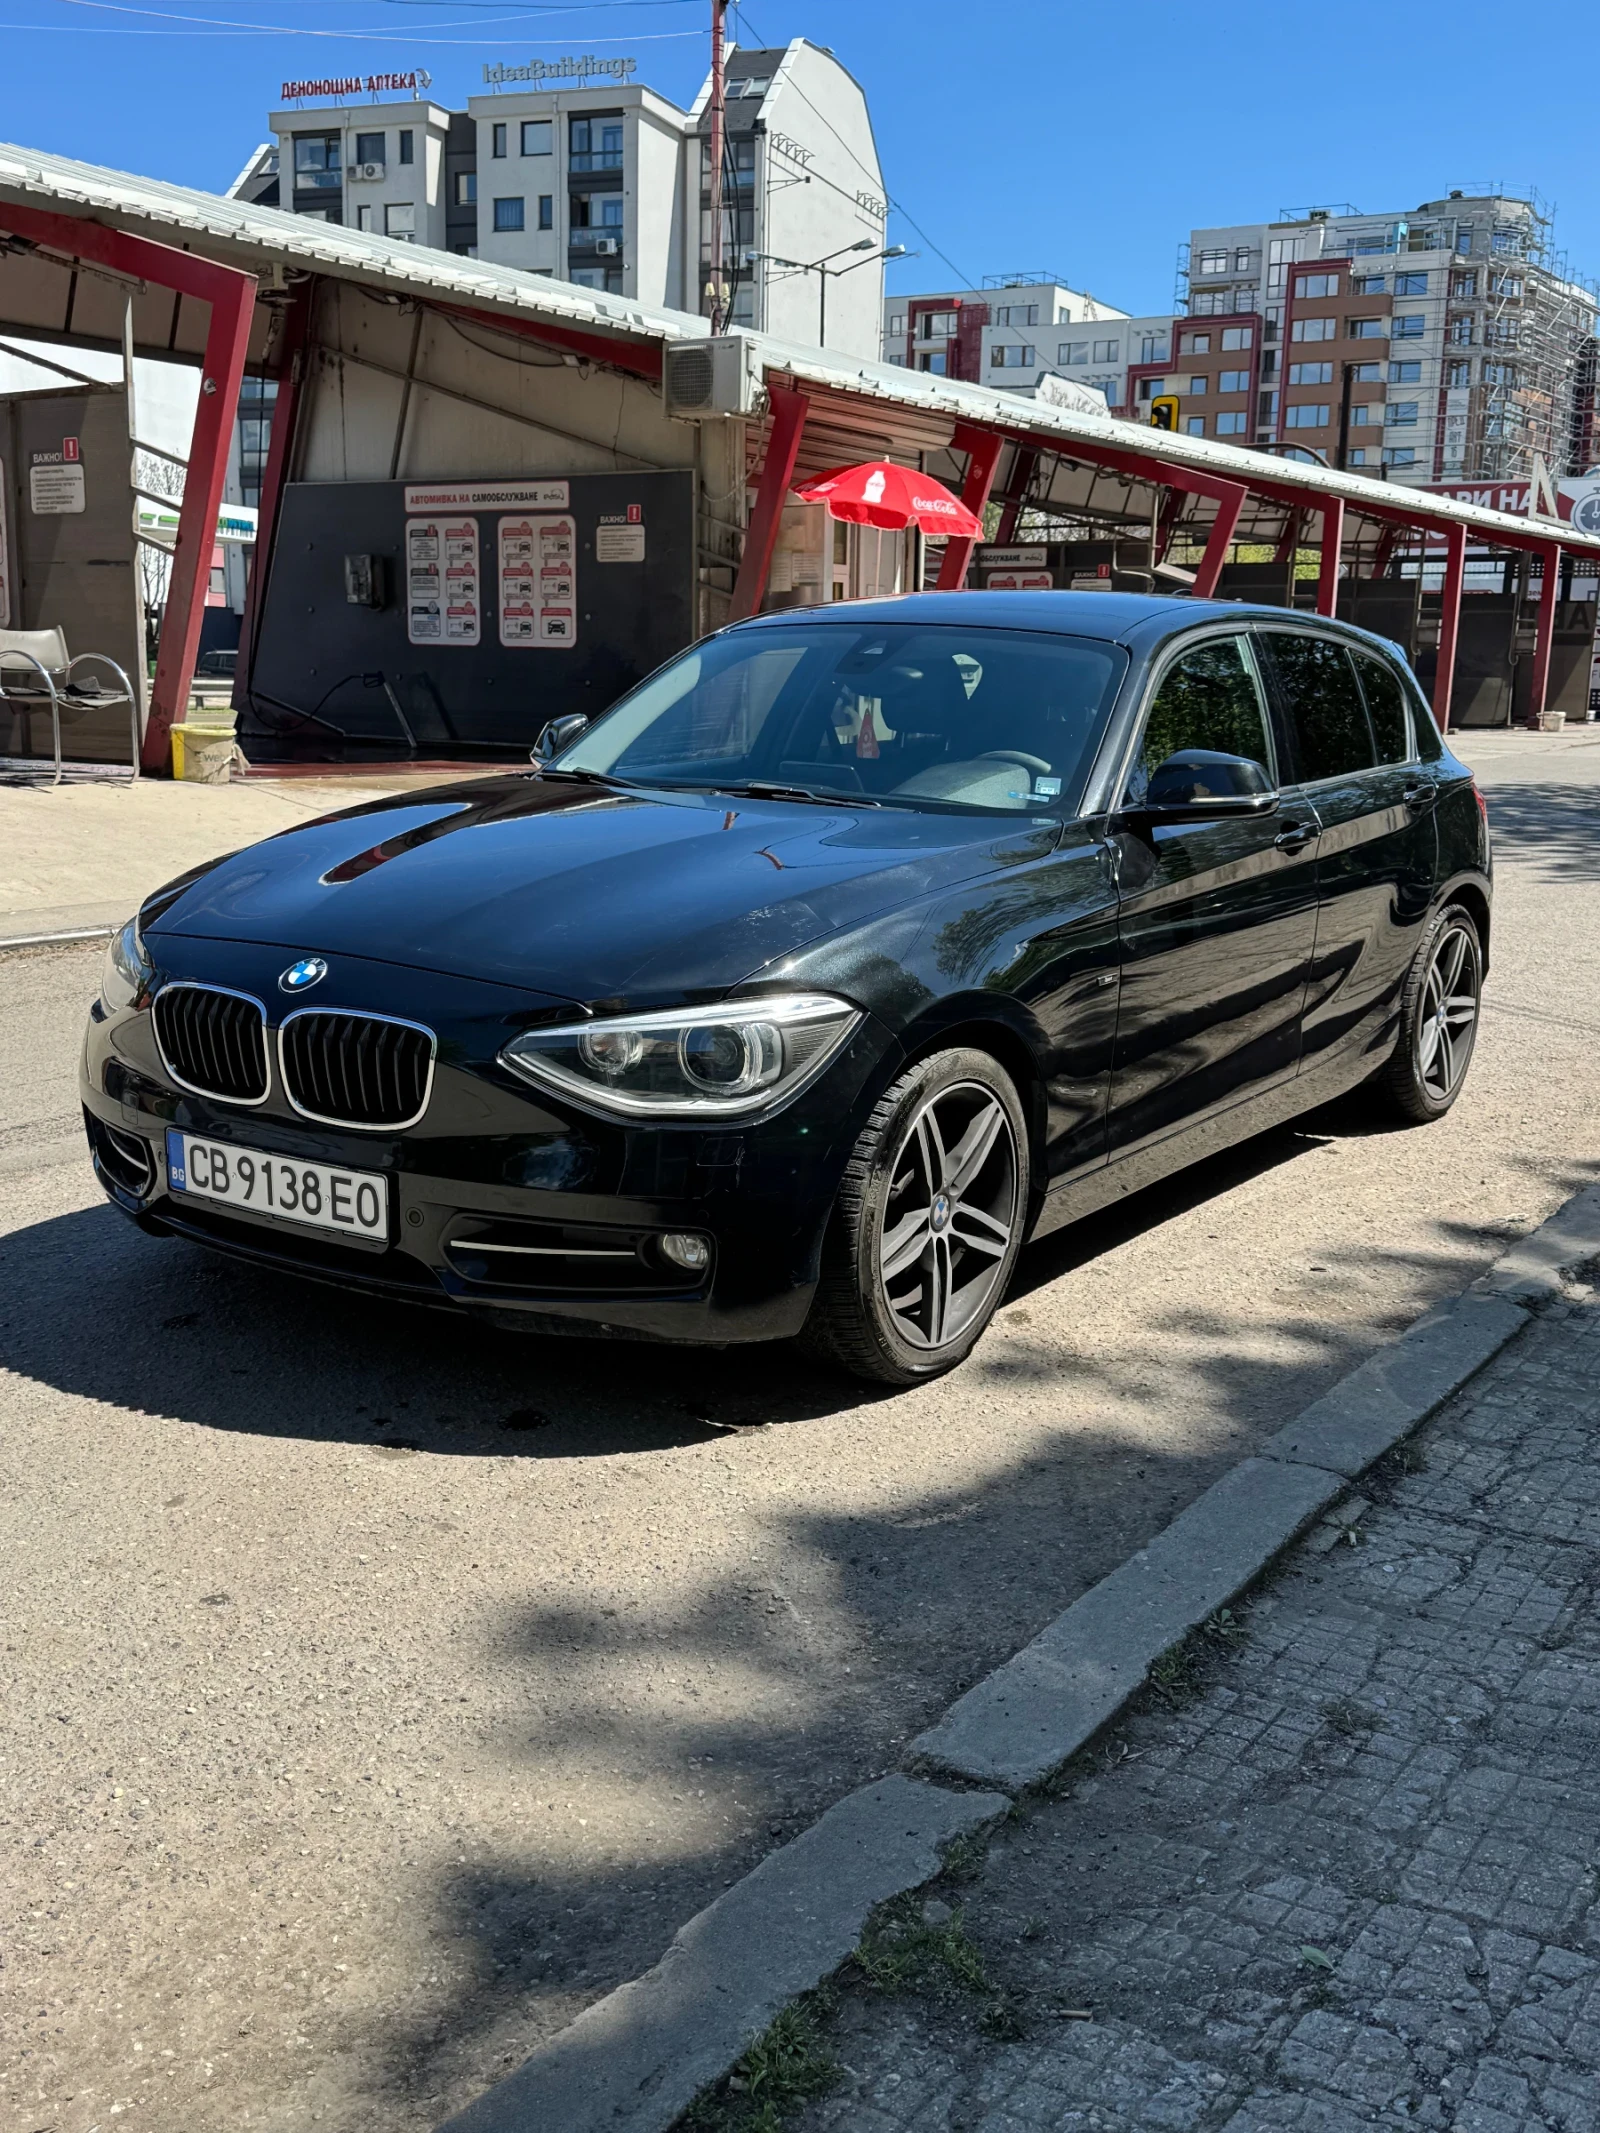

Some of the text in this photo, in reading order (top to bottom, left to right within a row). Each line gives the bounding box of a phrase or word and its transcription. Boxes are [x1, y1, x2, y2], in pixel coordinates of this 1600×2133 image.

[482, 55, 637, 83] IdeaBuildings
[281, 72, 418, 101] ДЕНОНОЩНА АПТЕКА
[409, 493, 457, 505] АВТОМИВКА
[459, 493, 471, 503] НА
[472, 491, 538, 503] САМООБСЛУЖВАНЕ
[912, 496, 958, 515] Coca-Cola
[171, 1166, 186, 1183] BG
